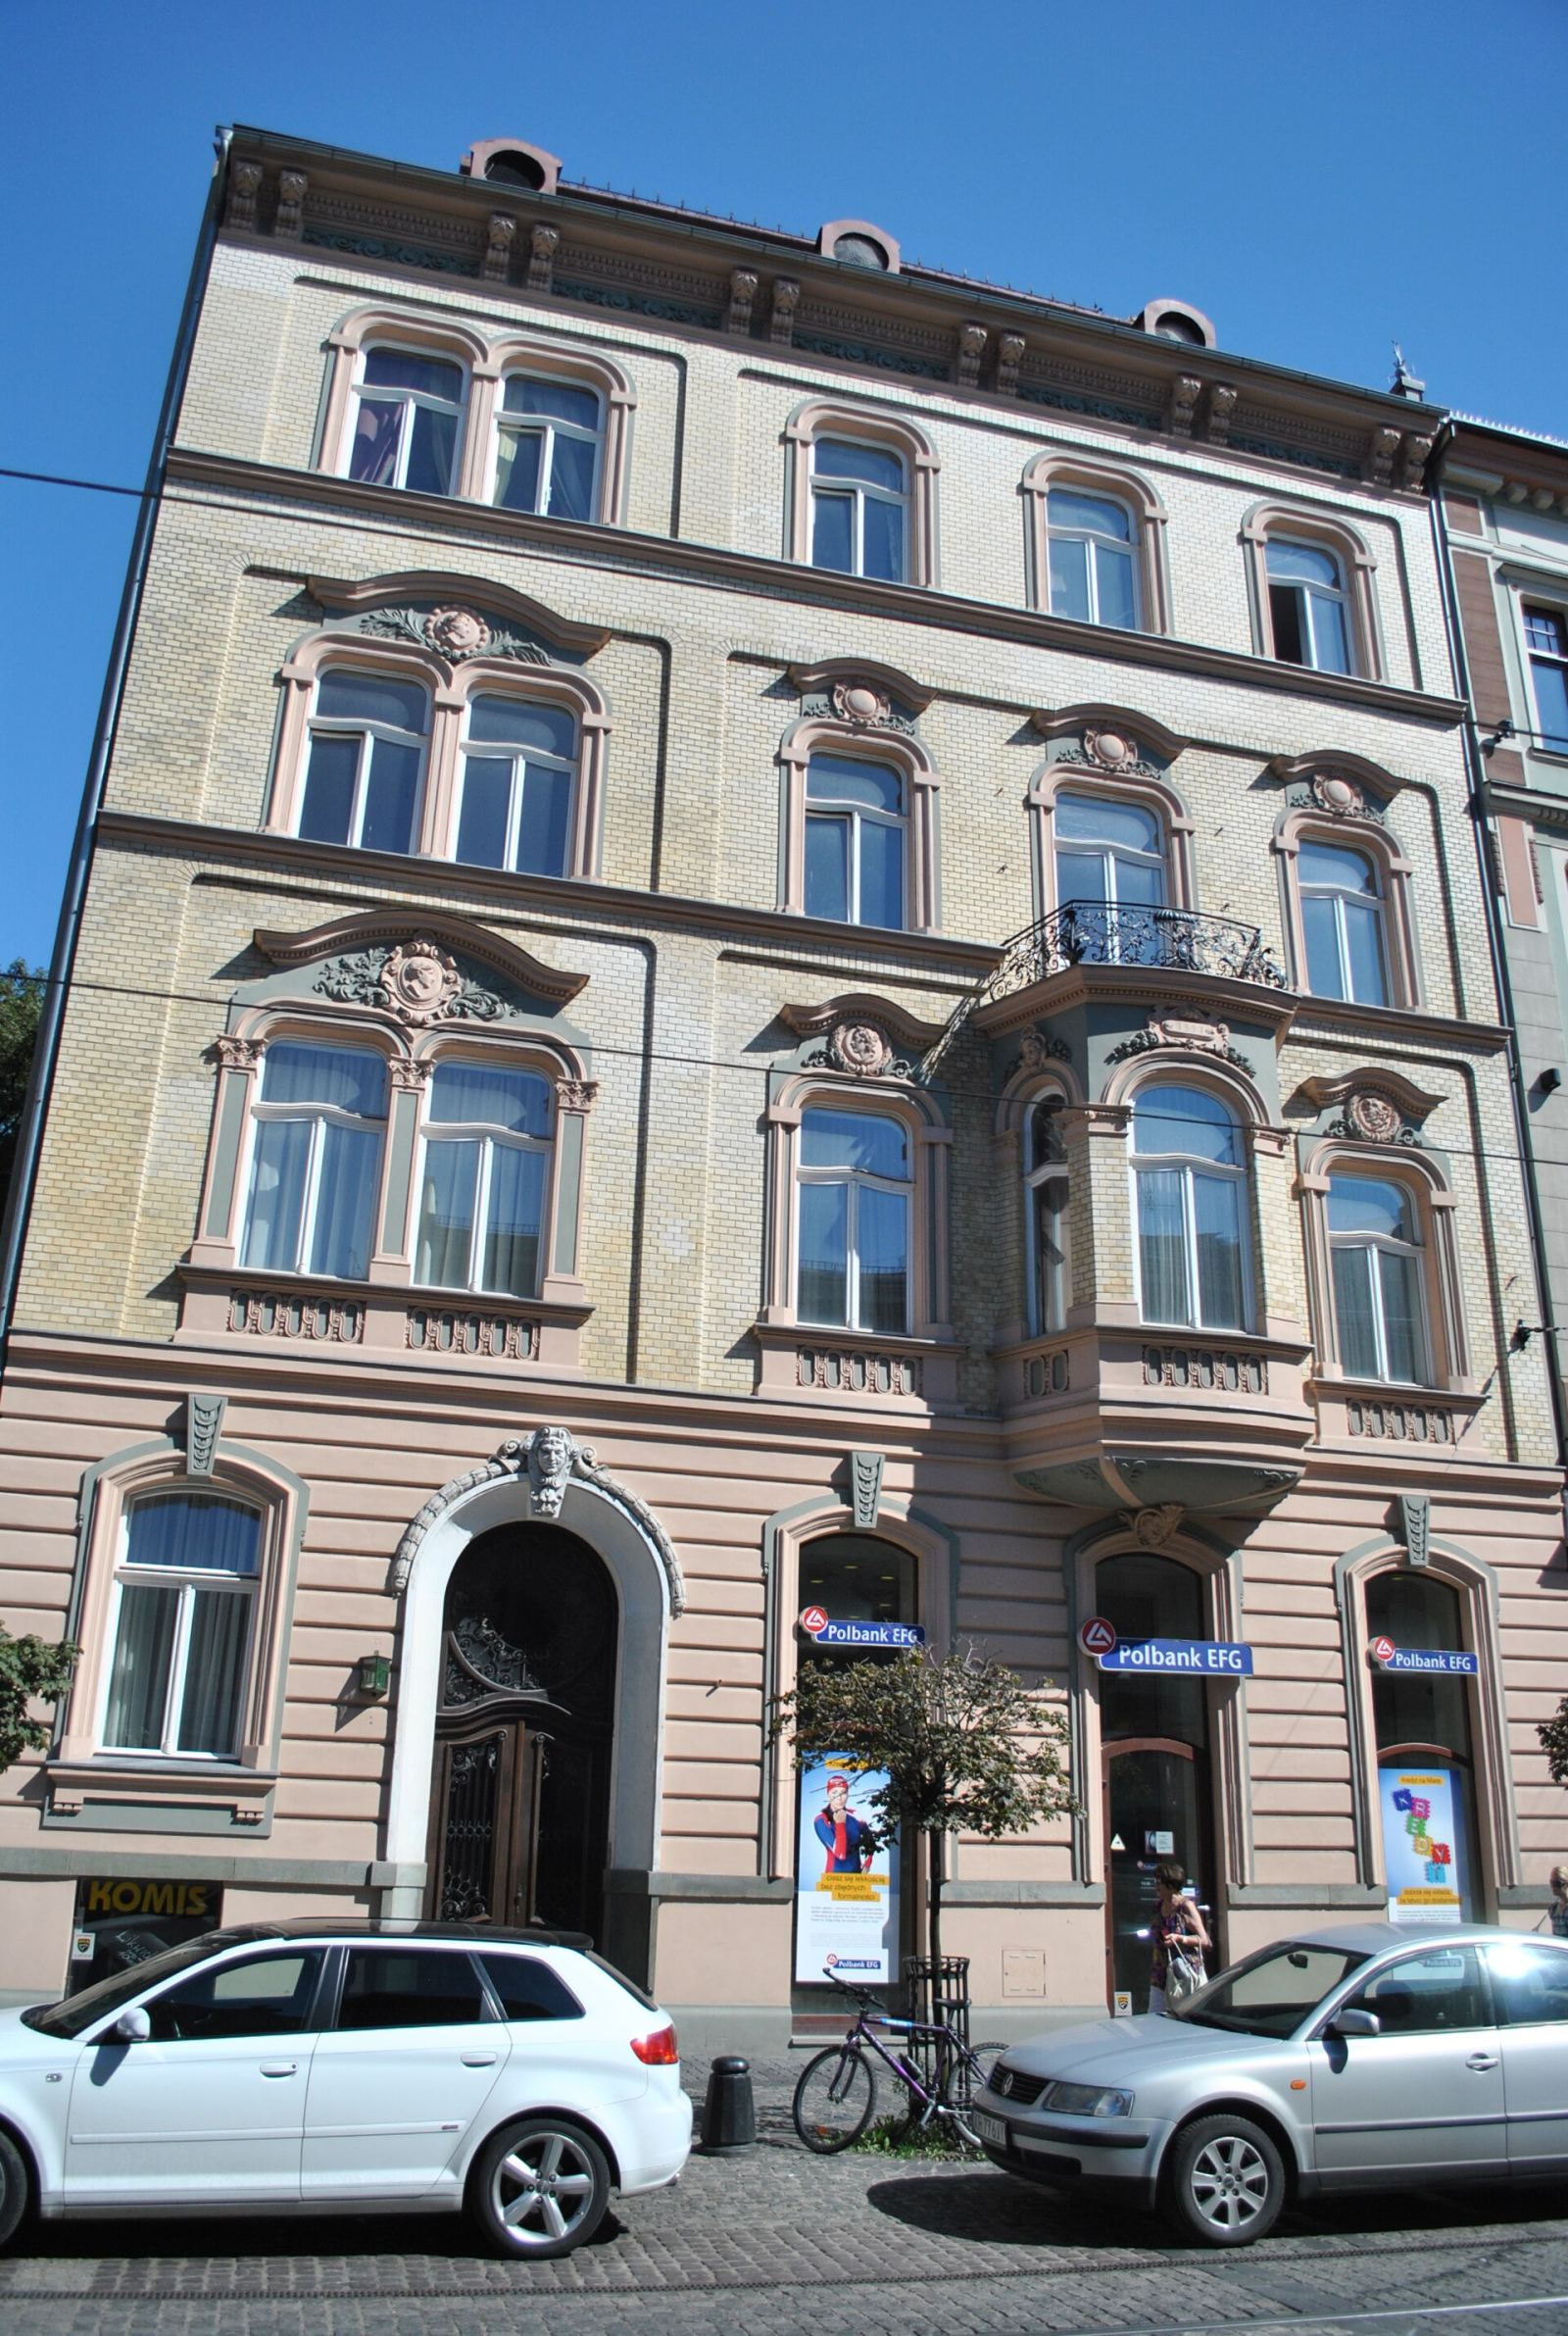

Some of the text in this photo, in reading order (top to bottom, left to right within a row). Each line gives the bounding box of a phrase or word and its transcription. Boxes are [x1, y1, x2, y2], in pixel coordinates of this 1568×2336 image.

[827, 1624, 917, 1644] Polbank EFG
[1118, 1644, 1243, 1669] Polbank EFG
[1396, 1653, 1471, 1670] Polbank EFG
[87, 1880, 208, 1916] KOMIS
